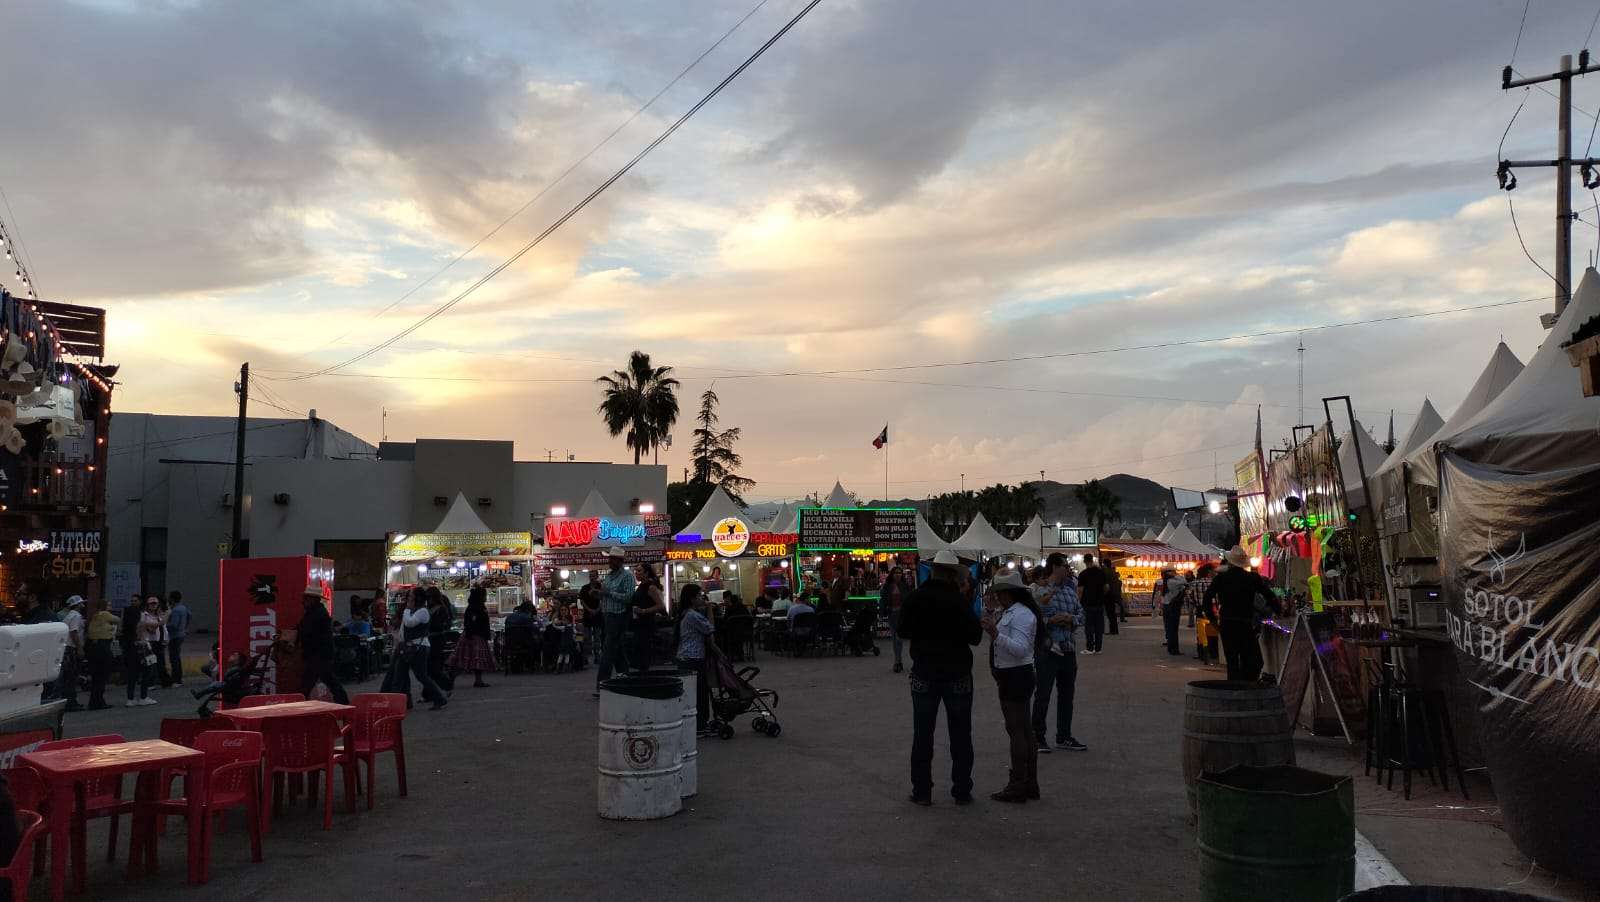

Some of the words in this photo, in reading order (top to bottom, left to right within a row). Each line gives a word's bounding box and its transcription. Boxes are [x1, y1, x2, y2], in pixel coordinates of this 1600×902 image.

[51, 532, 101, 553] LITROS
[1061, 530, 1079, 544] LITROS
[666, 551, 694, 560] TORTAS
[695, 550, 716, 558] TACOS
[1464, 587, 1543, 630] SOTOL
